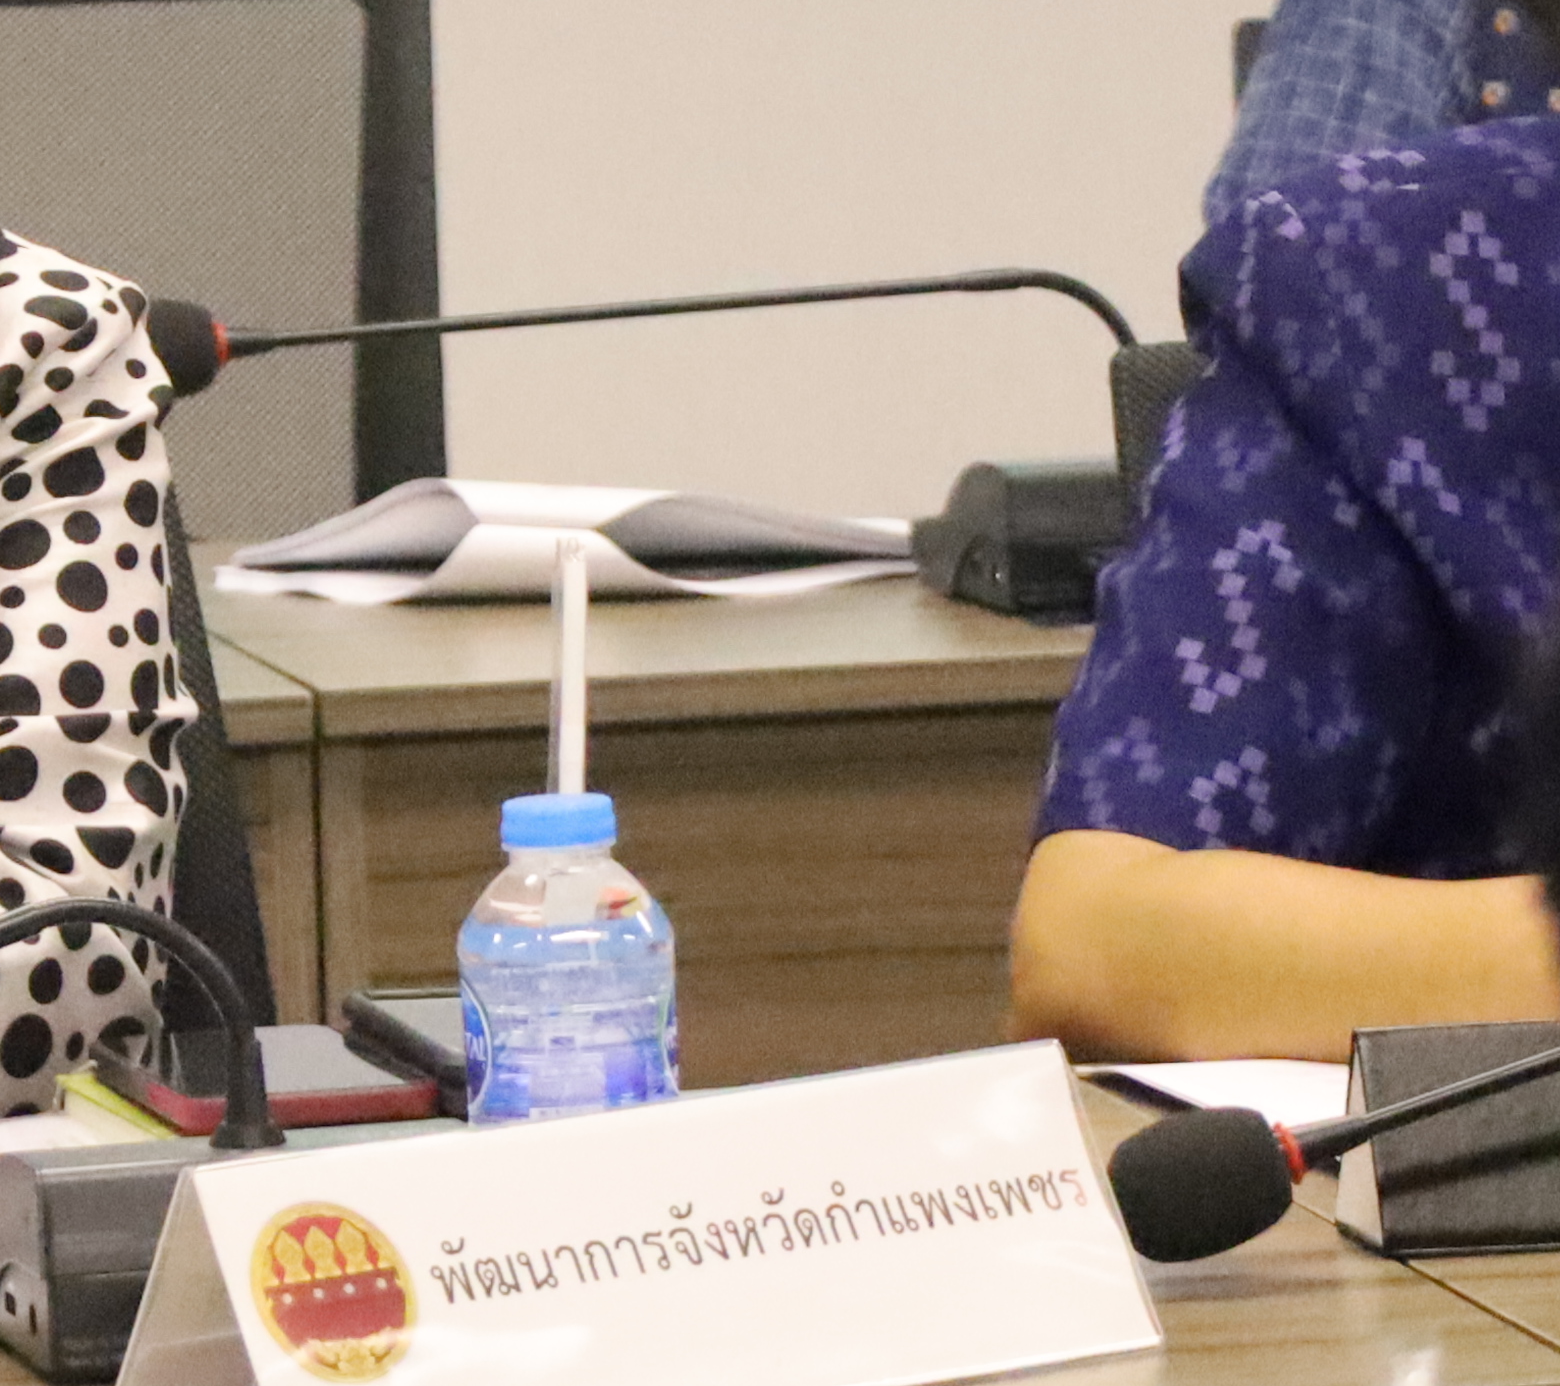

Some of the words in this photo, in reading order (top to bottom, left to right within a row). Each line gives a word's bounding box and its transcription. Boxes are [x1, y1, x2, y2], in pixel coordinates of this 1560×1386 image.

[430, 1167, 1087, 1305] พัฒนาการจังหวัดกำแพงเพชร
